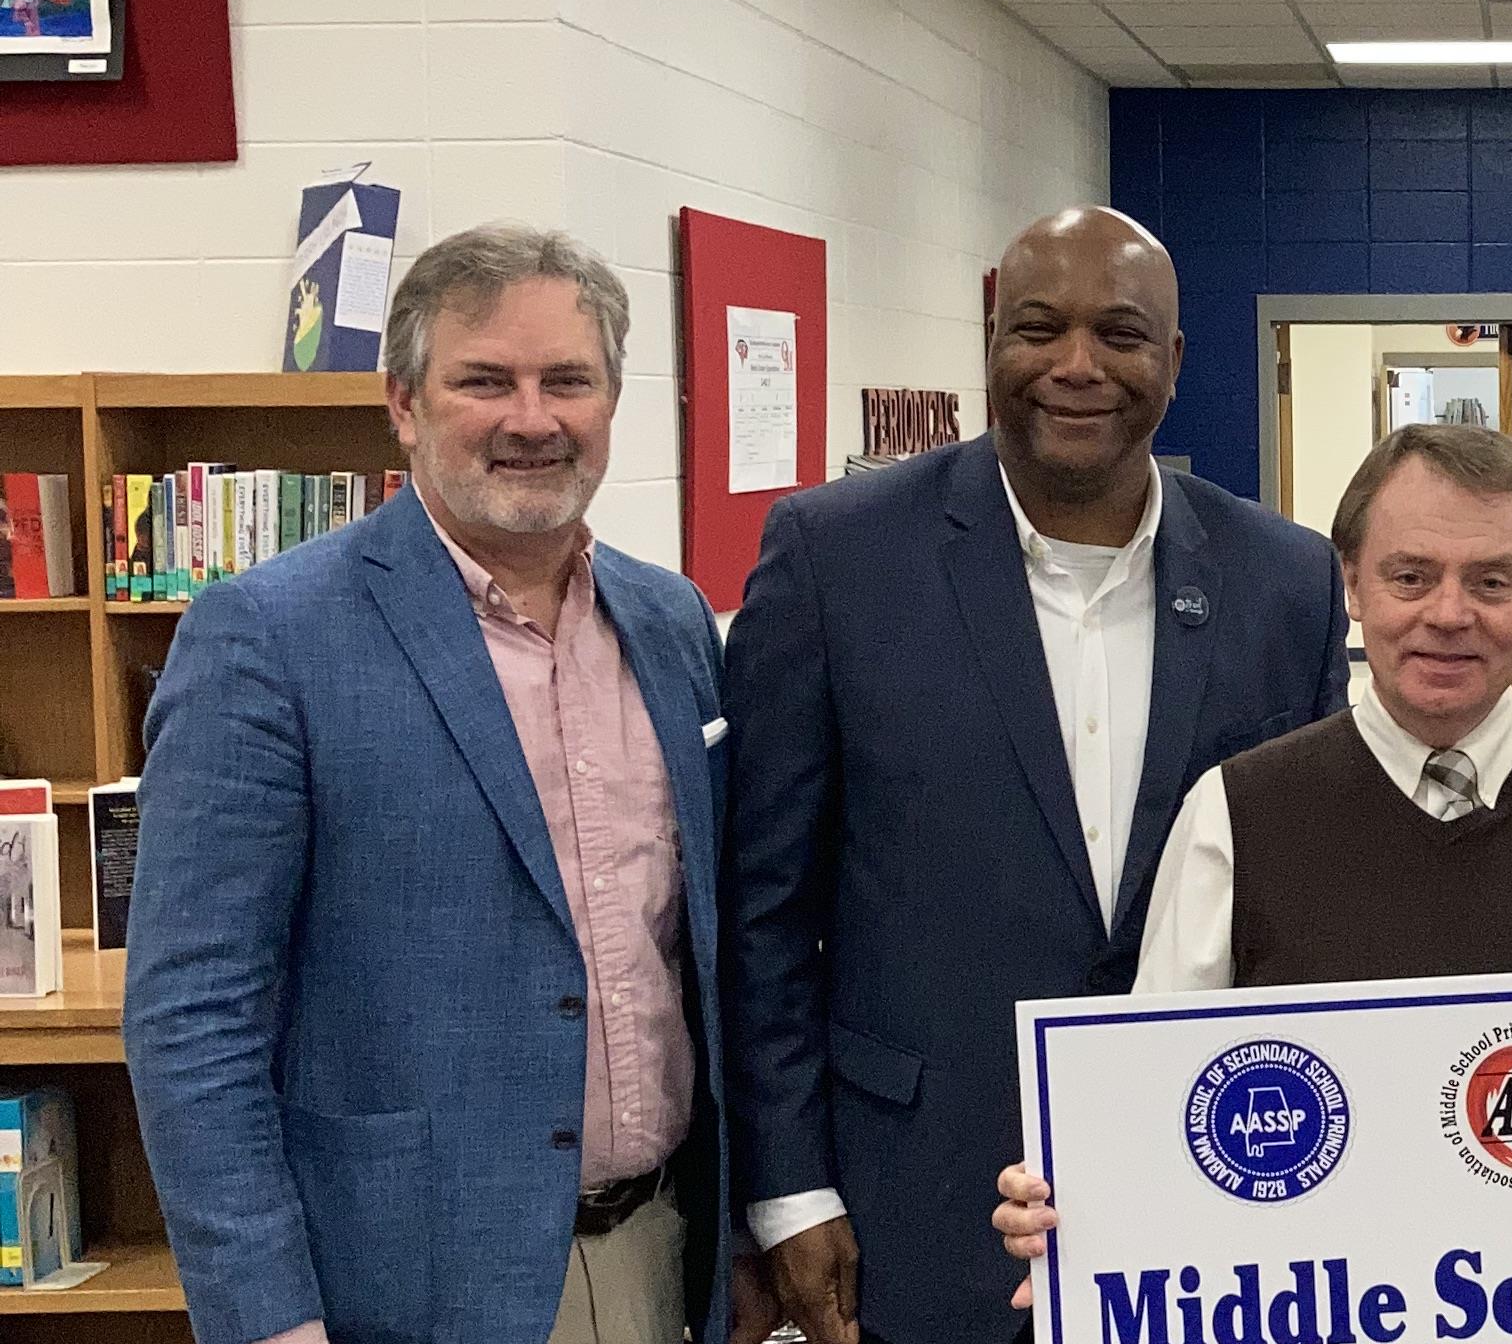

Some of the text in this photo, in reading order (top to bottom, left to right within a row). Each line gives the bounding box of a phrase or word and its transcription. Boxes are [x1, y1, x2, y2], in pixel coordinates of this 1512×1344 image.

[1223, 1044, 1309, 1072] SECONDARY
[1451, 1033, 1493, 1077] School
[1206, 1063, 1226, 1086] OF
[1305, 1060, 1344, 1113] SCHOOL
[1230, 1109, 1306, 1135] AASSP
[1440, 1079, 1459, 1129] Middle
[1297, 1114, 1346, 1188] PRINCIPALS
[1443, 1130, 1462, 1145] of
[1193, 1136, 1244, 1191] ALABAMA
[1252, 1180, 1287, 1198] 1928
